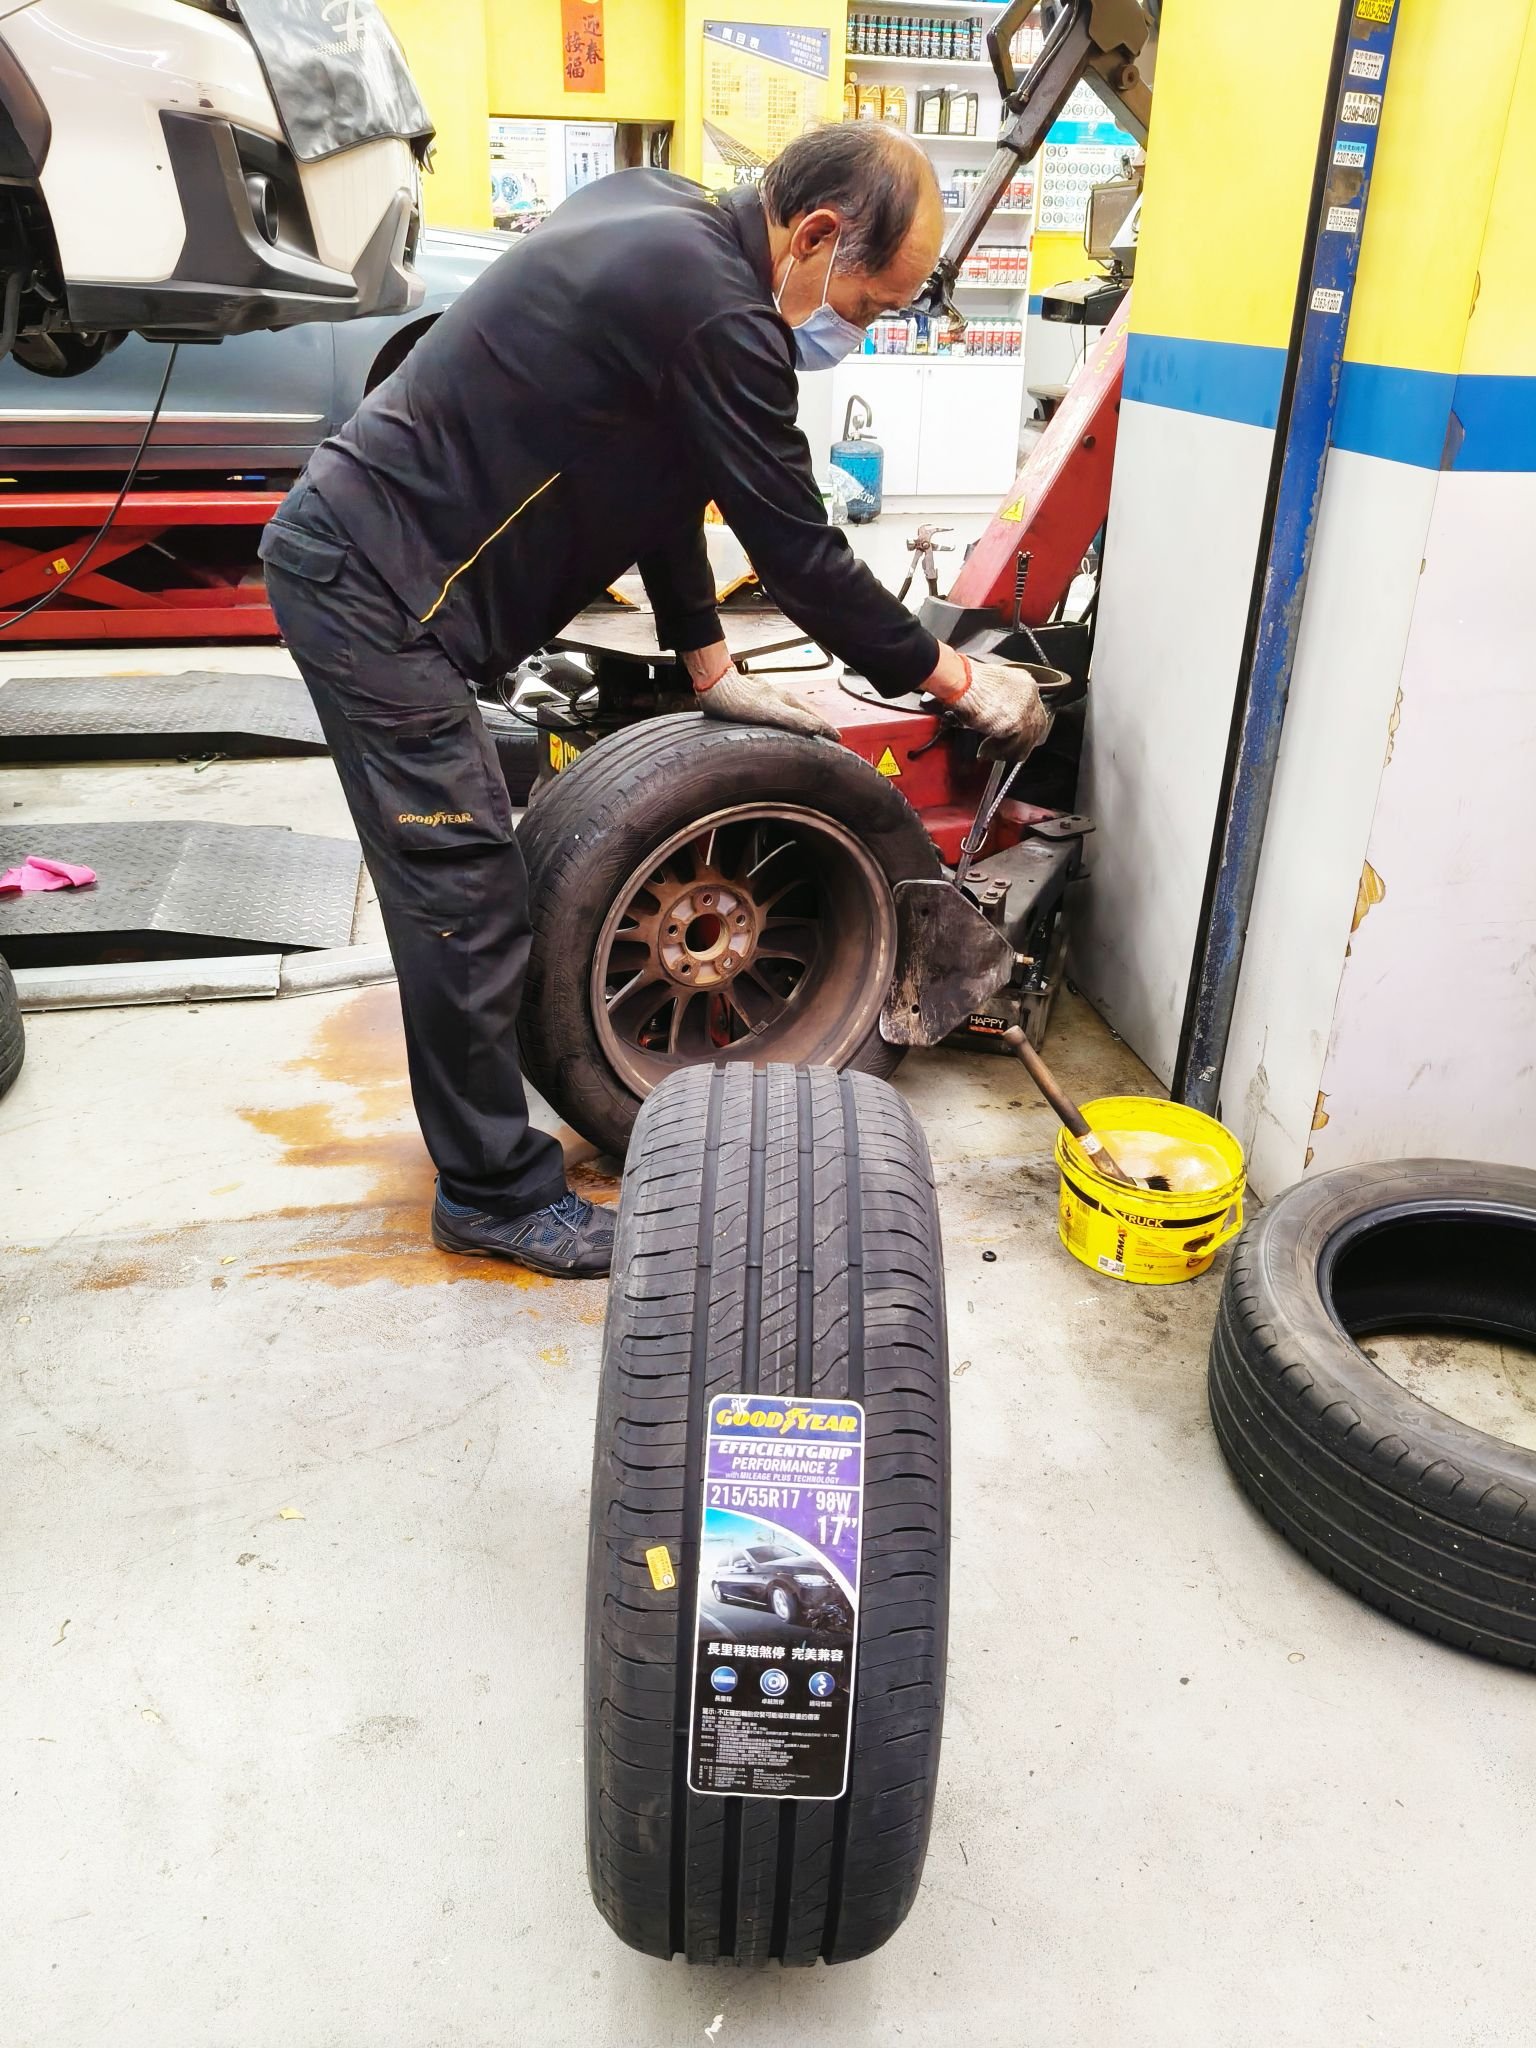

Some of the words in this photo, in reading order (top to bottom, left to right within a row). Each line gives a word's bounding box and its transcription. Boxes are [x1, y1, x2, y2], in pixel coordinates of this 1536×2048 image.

[582, 14, 604, 64] 迎春
[398, 812, 473, 828] GOODYEAR
[970, 1016, 1004, 1028] HAPPY
[1121, 1212, 1164, 1228] TRUCK
[716, 1407, 858, 1435] GOODYEAR
[718, 1441, 853, 1461] EFFICIENTGRIP
[732, 1456, 826, 1474] PERFORMANCE
[828, 1462, 838, 1475] 2
[740, 1472, 771, 1481] MILEAGE
[772, 1474, 792, 1482] PLUS
[793, 1475, 840, 1484] TECHNOLOGY
[711, 1485, 800, 1509] 215/55R17
[815, 1491, 852, 1511] 98W
[707, 1642, 786, 1660] 長里程短煞停
[791, 1647, 844, 1662] 完美兼容
